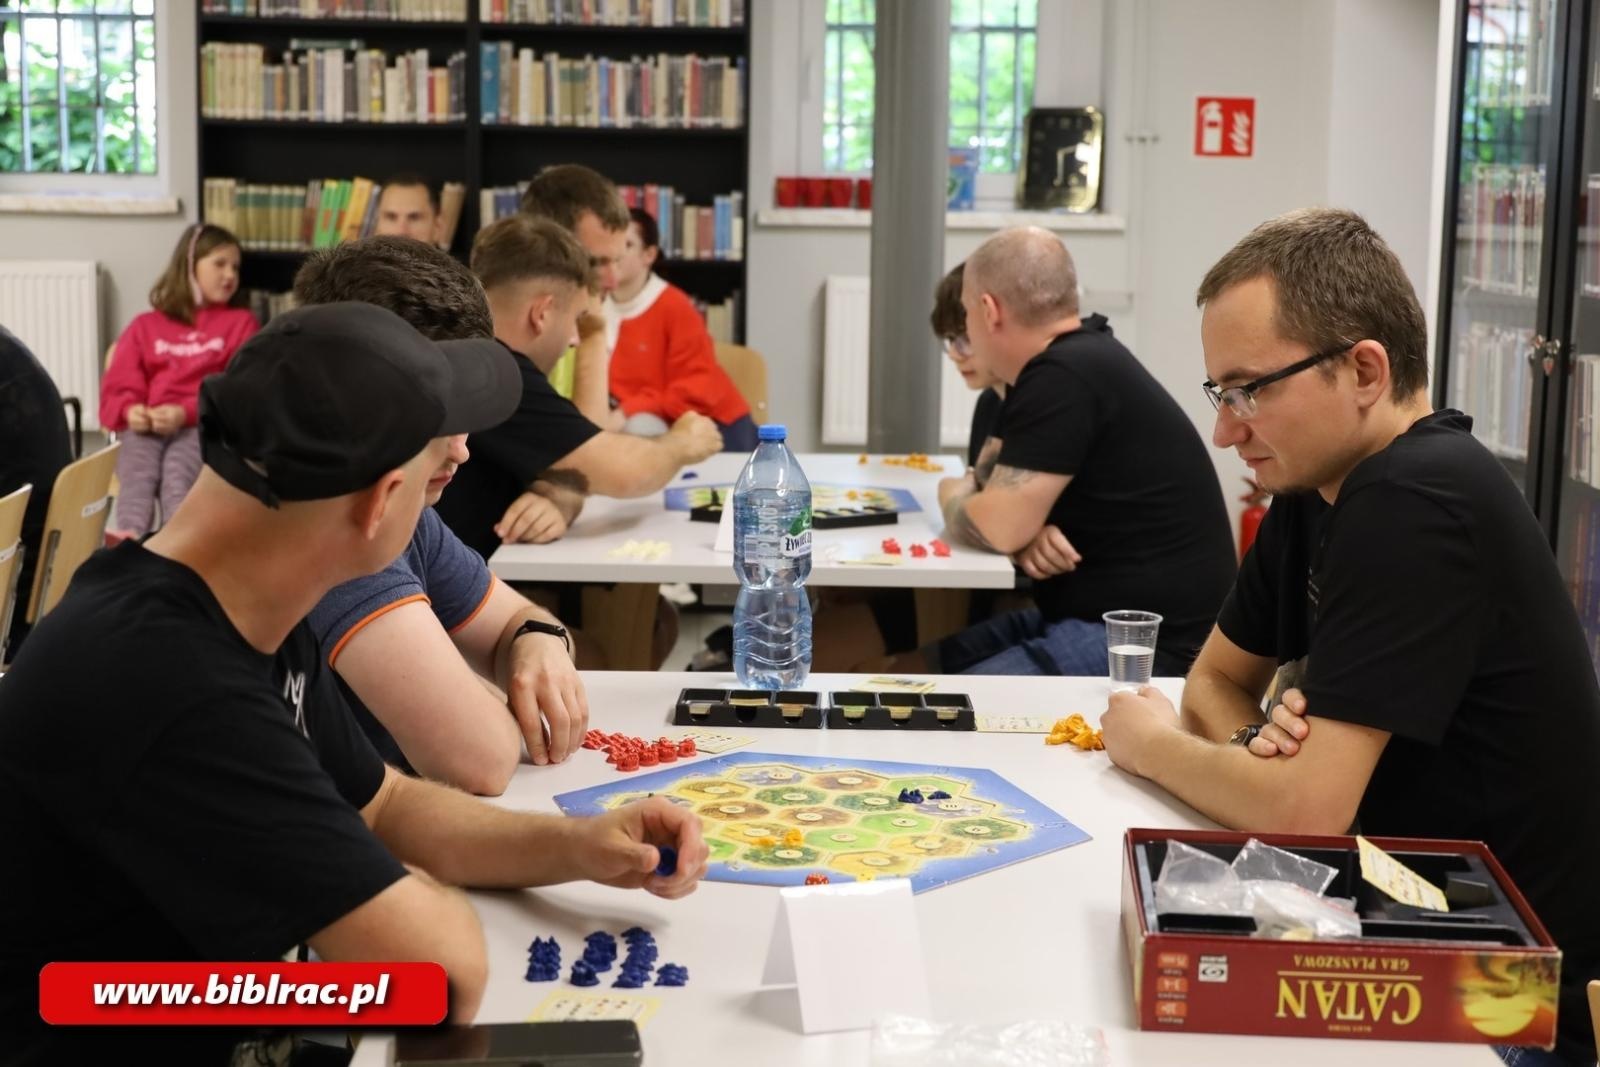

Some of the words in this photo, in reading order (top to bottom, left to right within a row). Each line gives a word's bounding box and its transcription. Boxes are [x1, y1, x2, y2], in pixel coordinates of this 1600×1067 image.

[1293, 954, 1377, 971] PLANSZOWA
[1381, 957, 1410, 971] GRA
[1275, 977, 1422, 1025] CATAN
